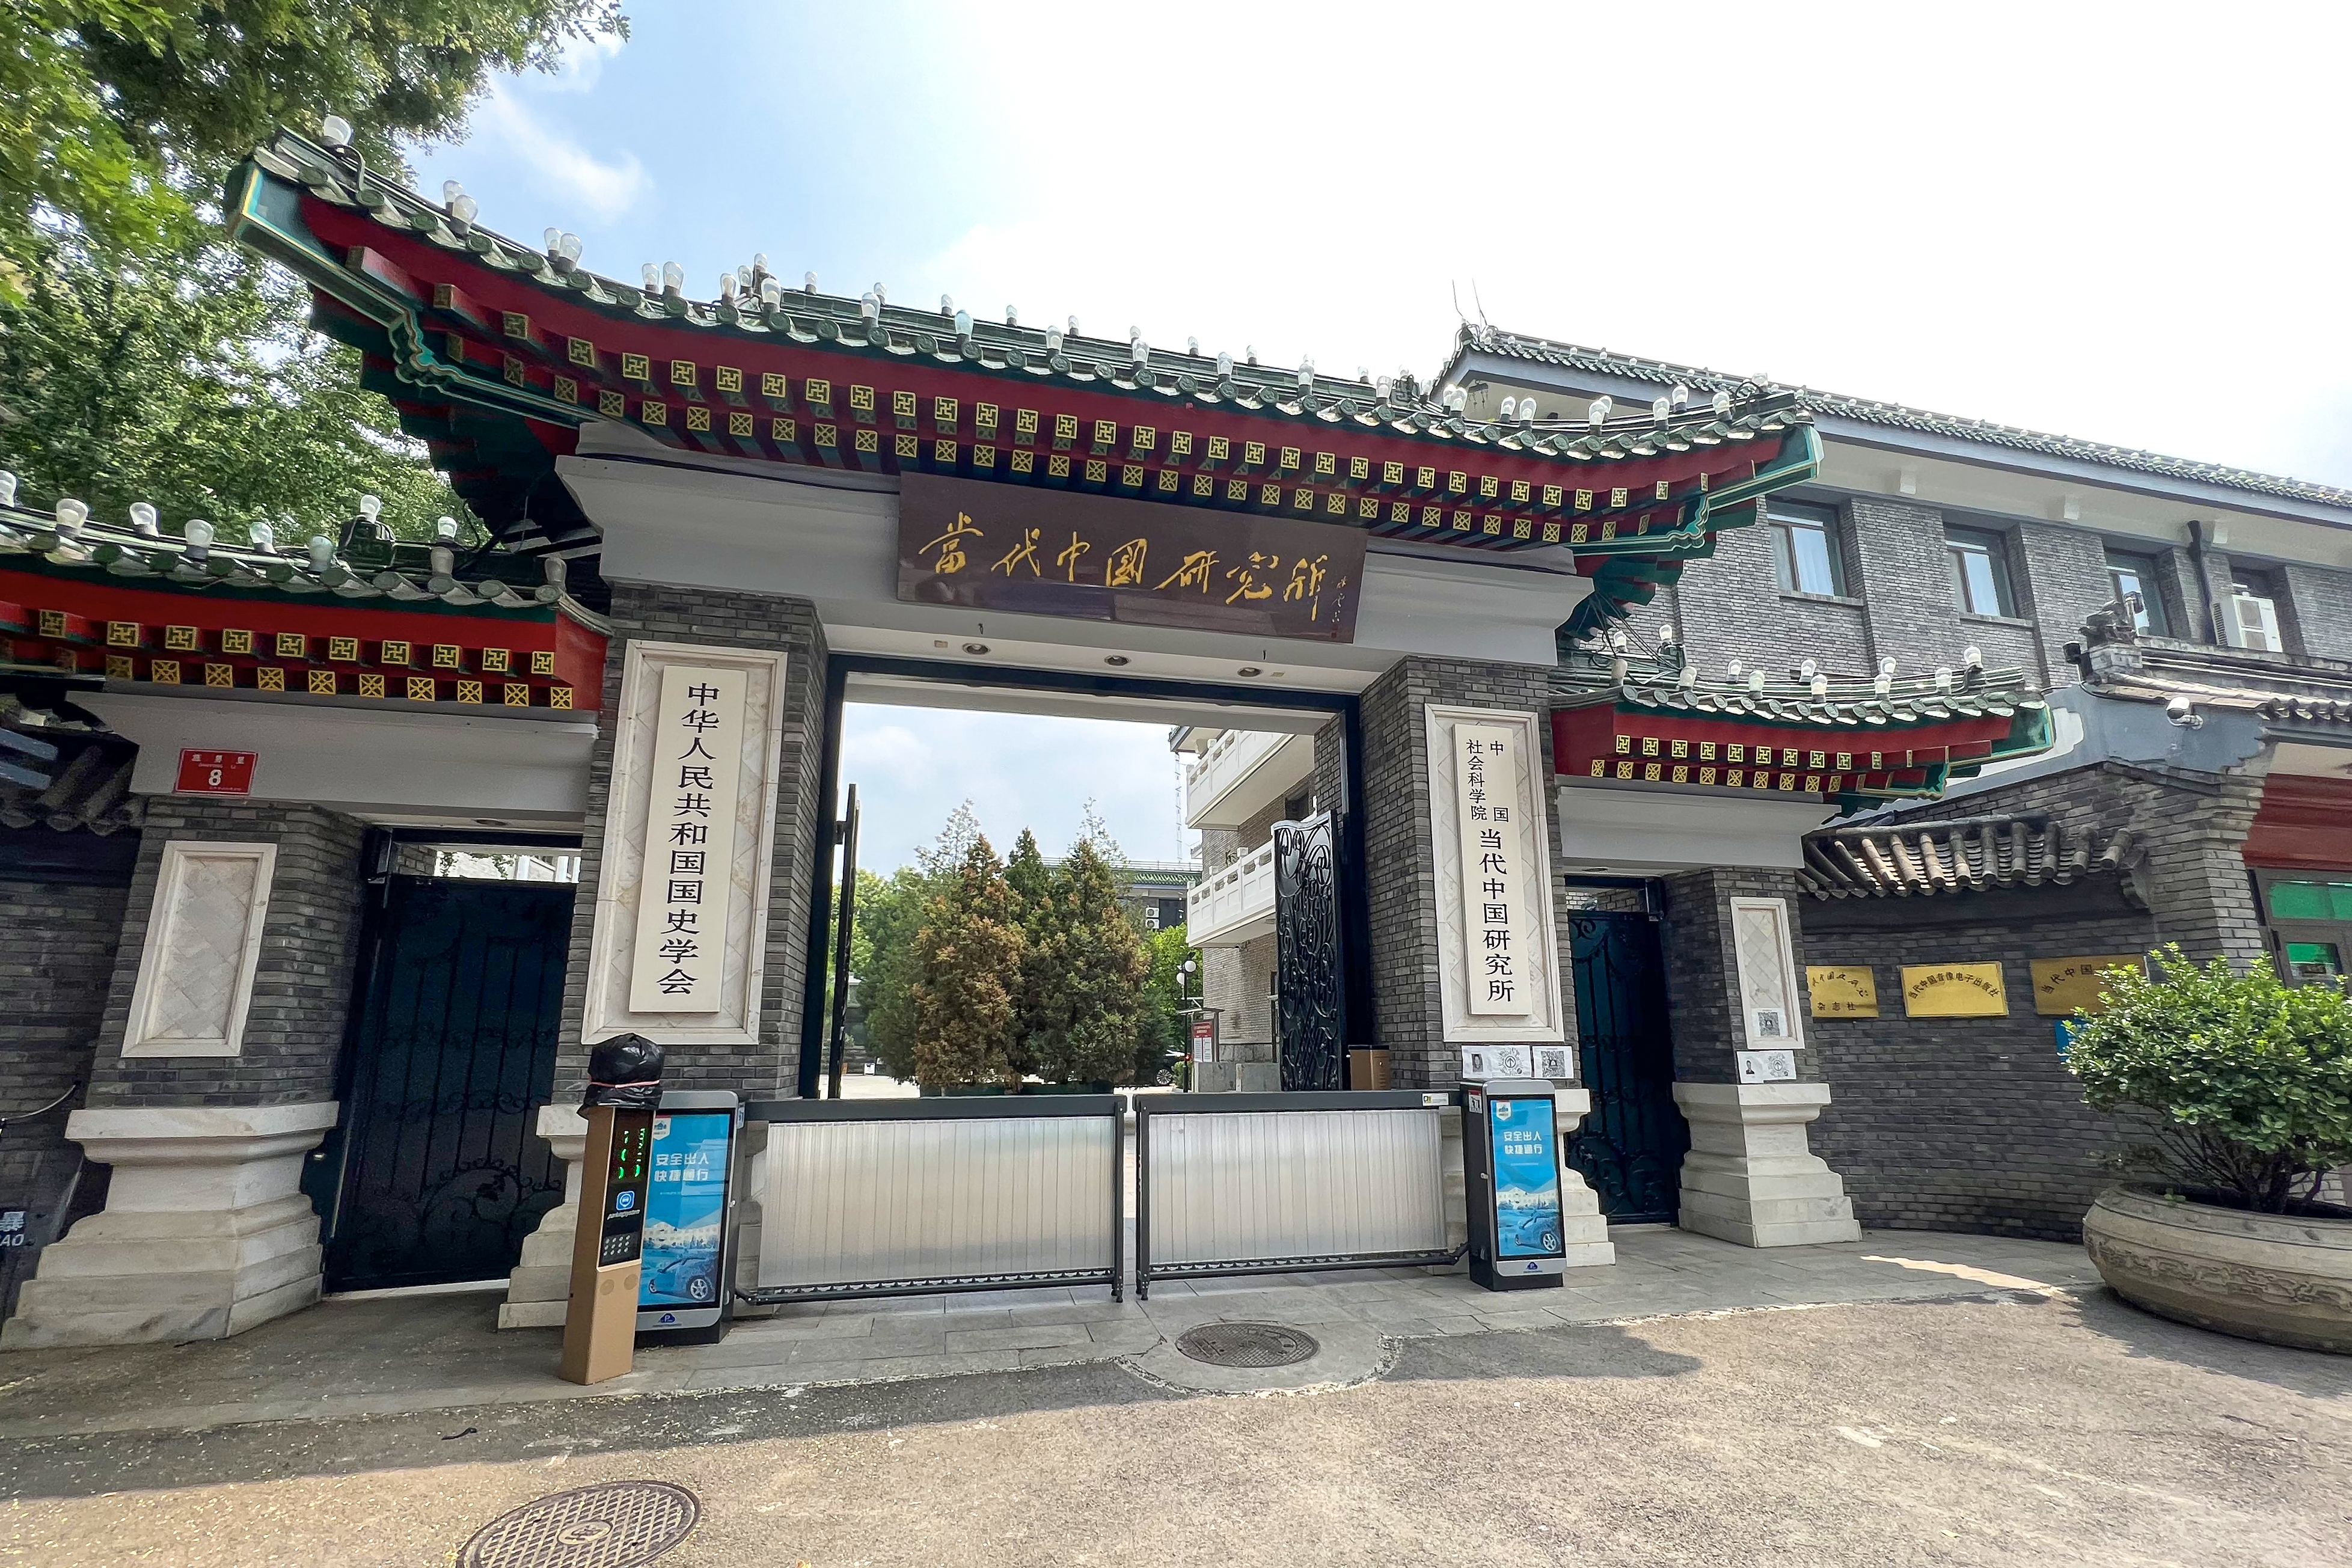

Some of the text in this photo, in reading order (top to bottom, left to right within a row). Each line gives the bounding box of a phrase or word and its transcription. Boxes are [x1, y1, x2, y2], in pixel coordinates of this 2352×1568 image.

[209, 769, 222, 786] 8
[1466, 738, 1487, 821] 社会科学院
[656, 682, 720, 994] 中华人民共和国国史学会
[1479, 828, 1515, 1002] 当代中国研究所
[1908, 971, 2000, 999] 当代中国音像电子出版社
[2041, 964, 2107, 994] 当代中国
[1818, 1001, 1856, 1011] 杂志社
